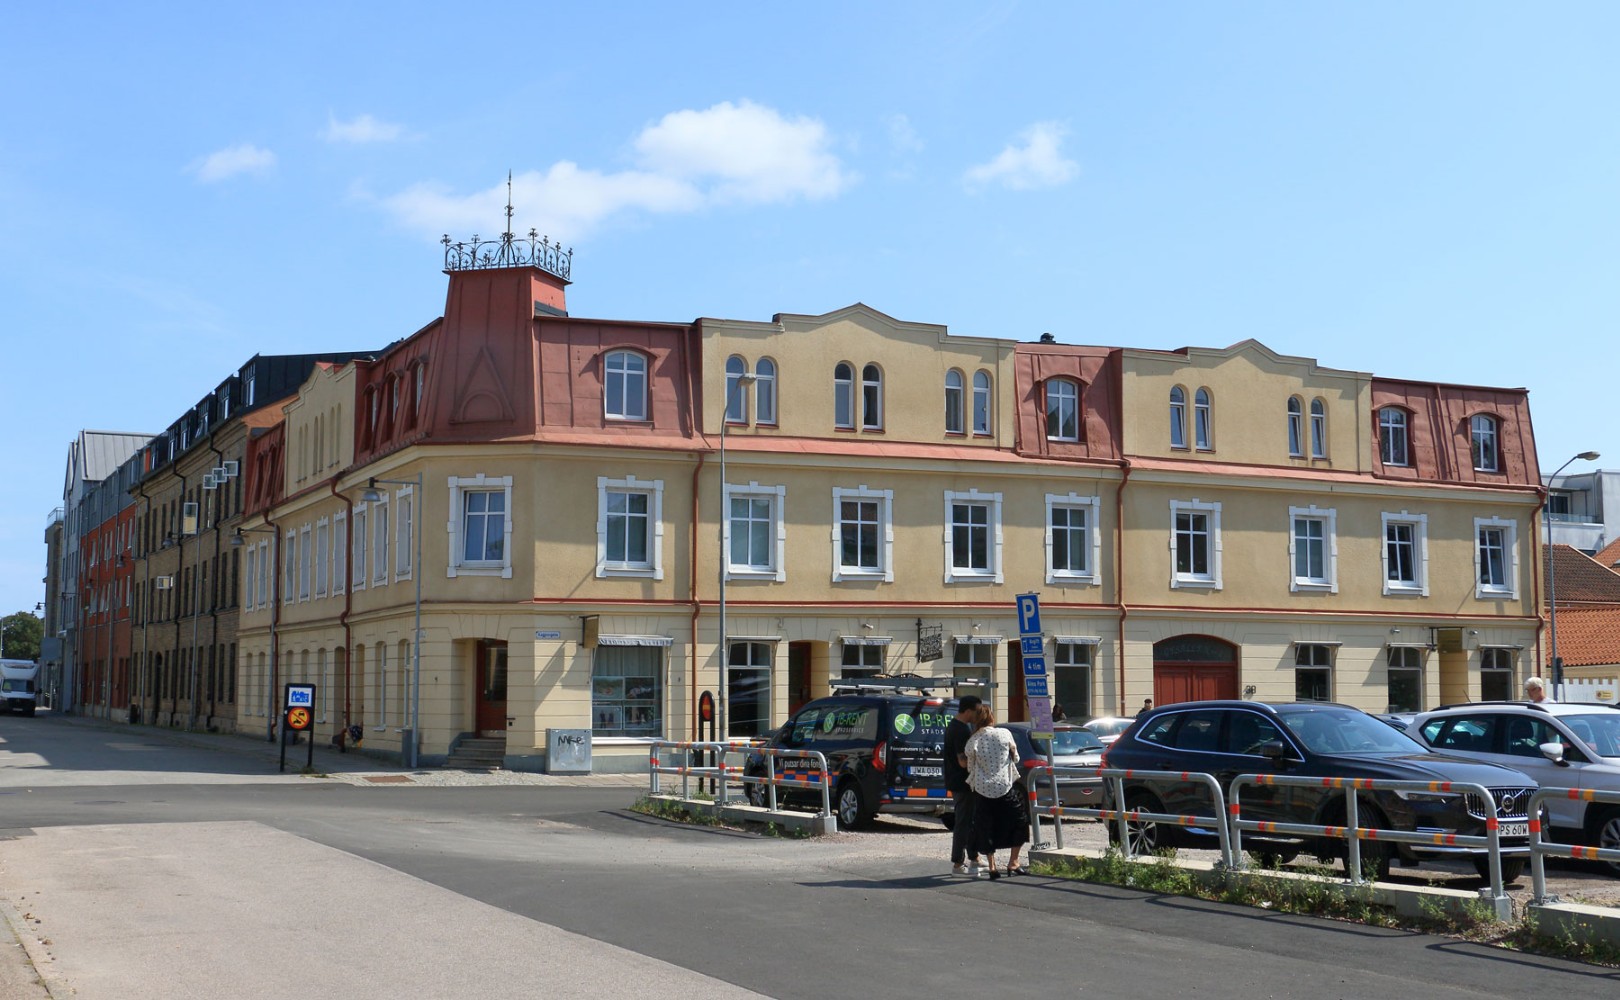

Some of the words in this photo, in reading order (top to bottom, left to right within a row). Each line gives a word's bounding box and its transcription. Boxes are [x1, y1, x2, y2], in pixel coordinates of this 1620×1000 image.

[1022, 599, 1035, 630] P
[1497, 824, 1510, 835] PS
[1512, 824, 1527, 835] 60W
